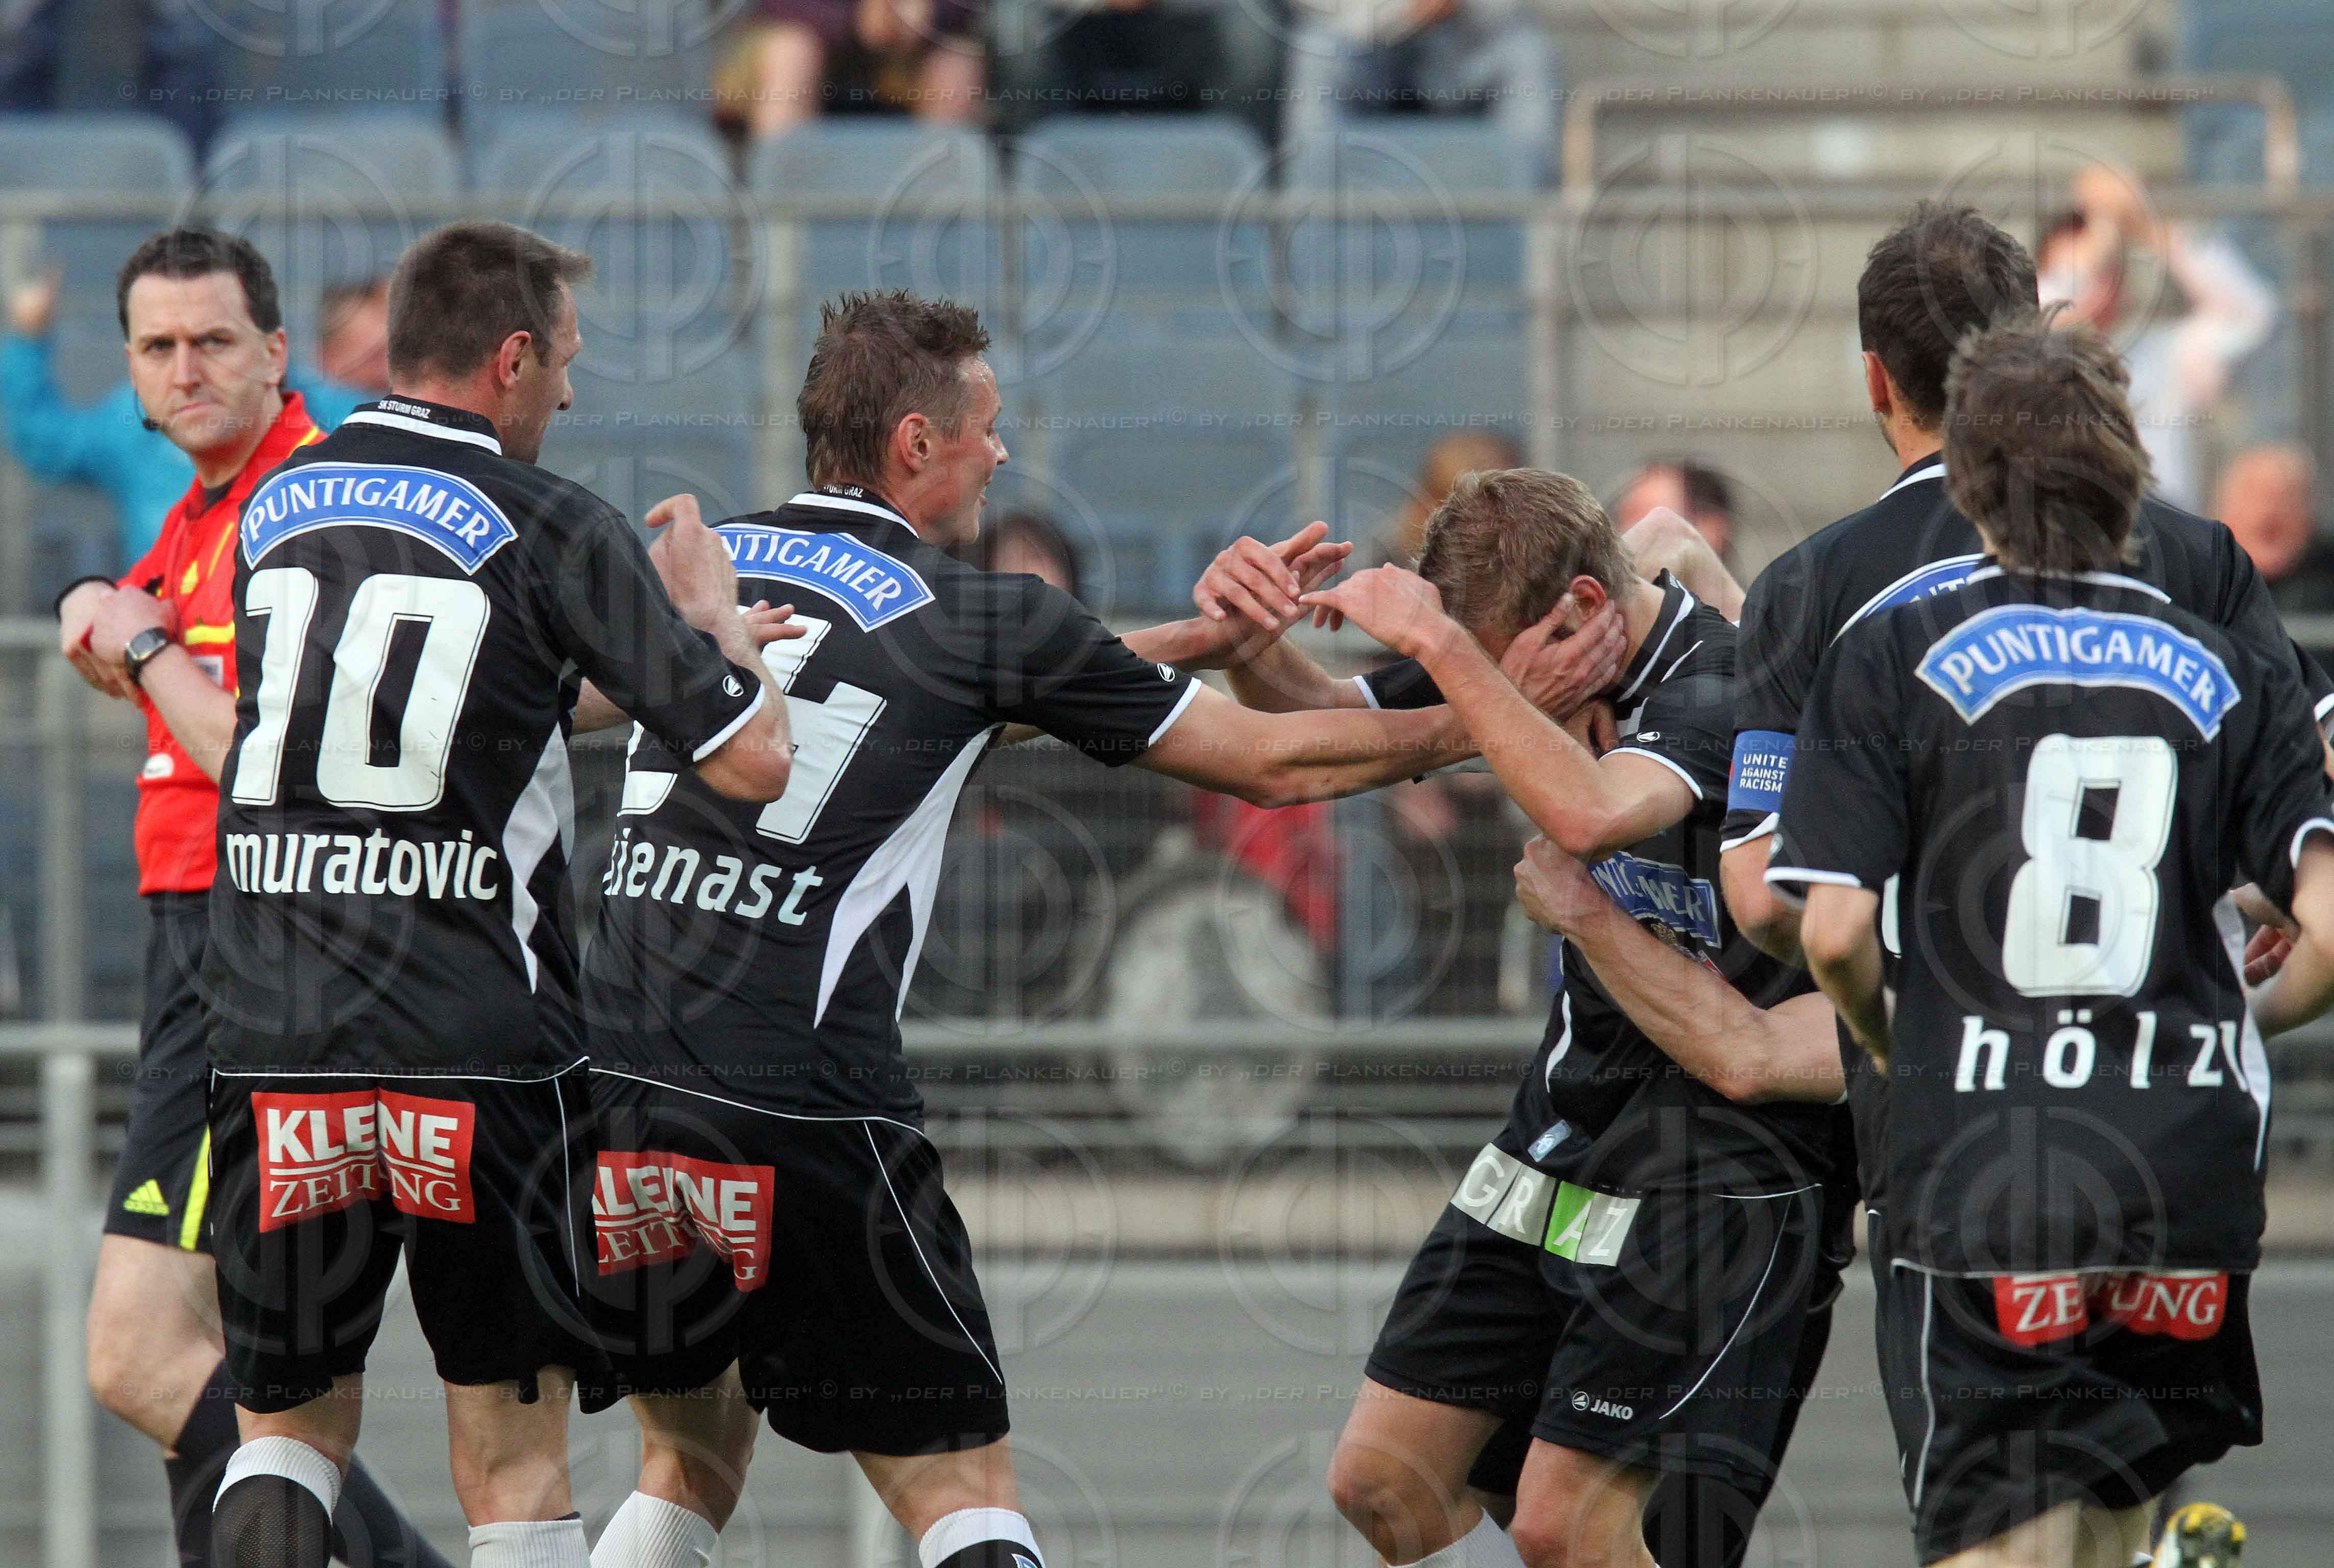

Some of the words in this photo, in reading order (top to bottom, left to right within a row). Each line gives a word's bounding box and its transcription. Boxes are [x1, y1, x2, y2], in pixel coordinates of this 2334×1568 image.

[378, 400, 388, 410] SK
[387, 400, 411, 414] STURM
[410, 405, 431, 419] GRAZ
[245, 478, 491, 549] PUNTIGAMER
[721, 534, 903, 610] NTIGAMER
[232, 567, 491, 811] 10
[1941, 622, 2217, 713] PUNTIGAMER
[1739, 778, 1782, 793] RACISM
[1741, 767, 1785, 781] AGAINST
[1743, 753, 1788, 769] UNITE
[226, 828, 498, 900] muratovic
[2002, 733, 2178, 997] 8
[267, 1100, 458, 1168] KLENE
[270, 1163, 461, 1218] ZEITNG
[2013, 1278, 2218, 1333] ZEUNG
[1590, 1399, 1634, 1420] JAKO
